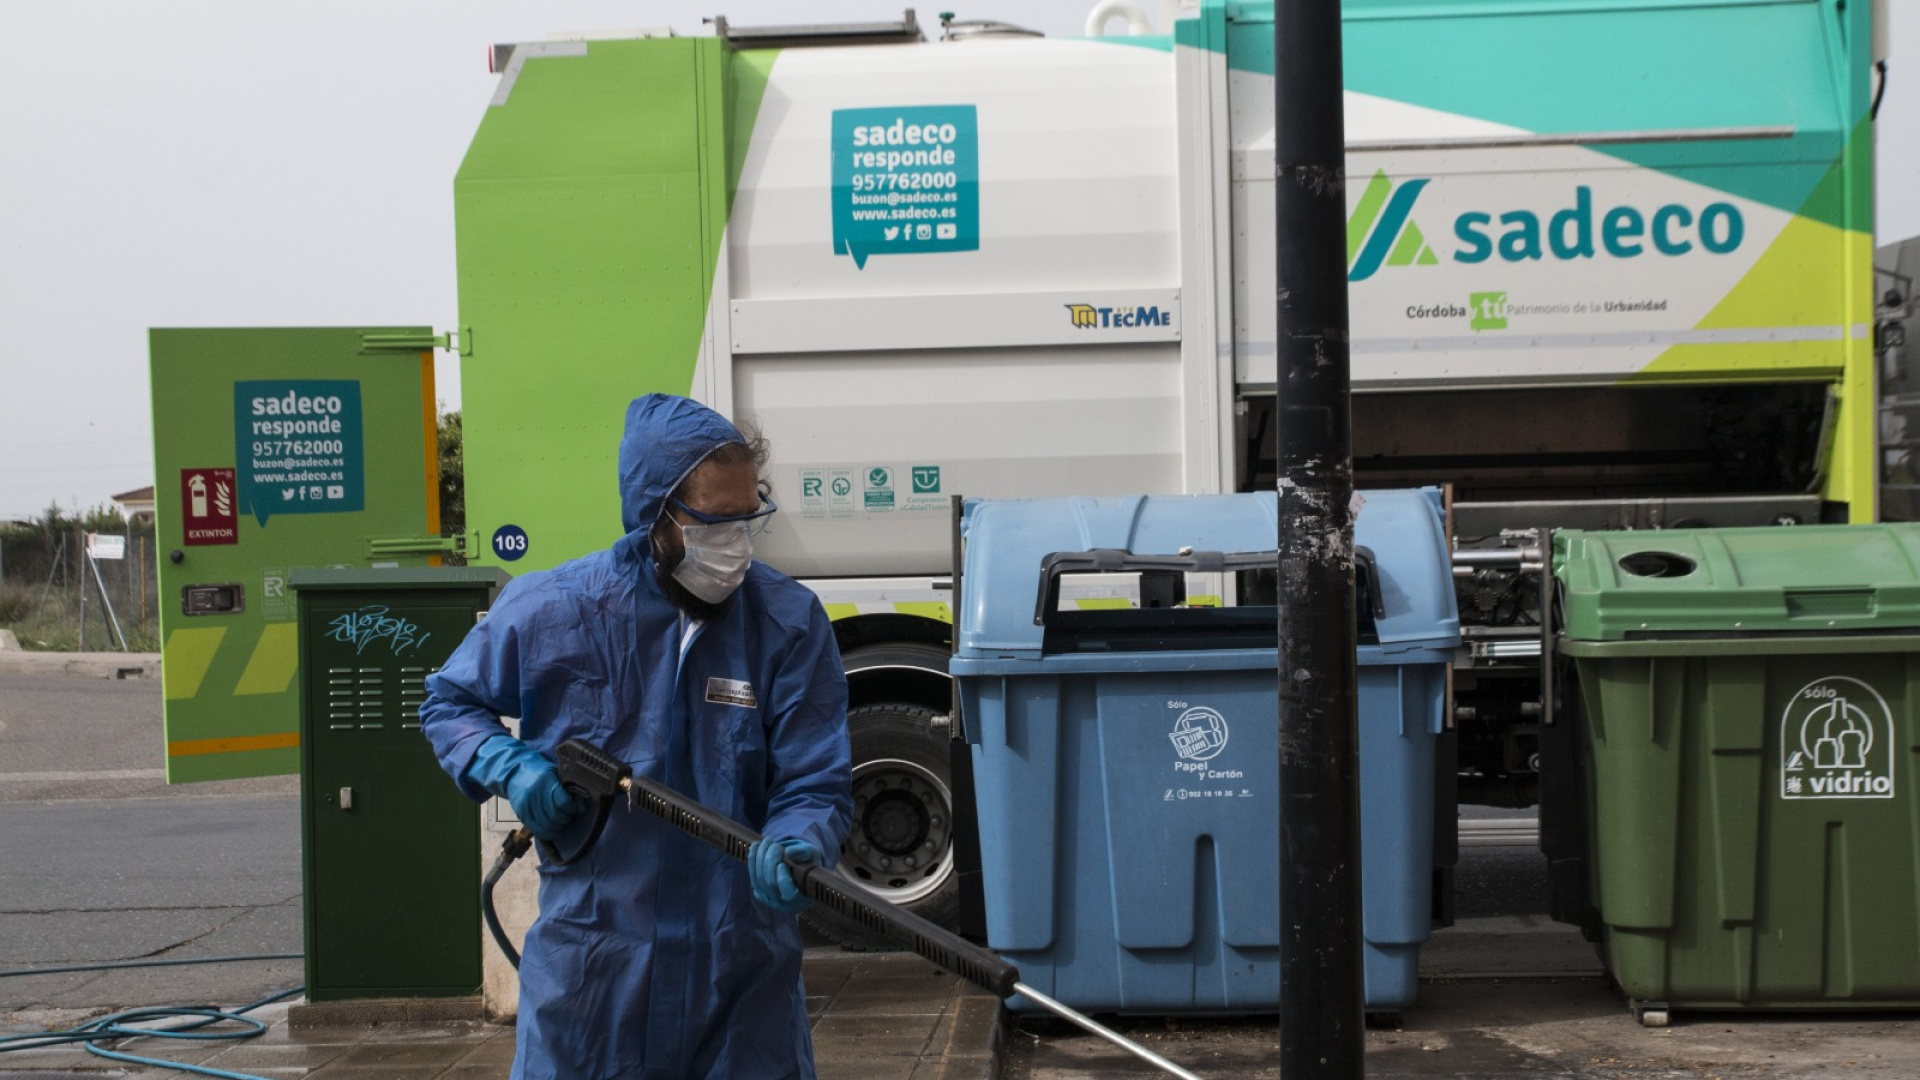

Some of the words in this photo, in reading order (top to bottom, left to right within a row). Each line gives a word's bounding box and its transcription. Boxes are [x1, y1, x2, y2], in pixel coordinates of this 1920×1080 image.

[853, 118, 957, 146] sadeco
[853, 145, 955, 172] responde
[852, 172, 957, 191] 957762000
[852, 191, 957, 206] buzon@sadeco.es
[852, 206, 956, 221] www.sadeco.es
[1453, 185, 1744, 264] sadeco
[1406, 304, 1466, 319] Córdoba
[1507, 303, 1570, 315] Patrimonio
[1573, 301, 1587, 313] de
[1590, 301, 1602, 313] la
[1603, 299, 1668, 313] Urbanidad
[252, 390, 342, 415] sadeco
[252, 415, 341, 439] responde
[252, 439, 343, 456] 957762000
[252, 457, 344, 469] buzon@sadeco.es
[253, 470, 343, 482] www.sadeco.es
[188, 529, 233, 539] EXTINTOR
[495, 535, 525, 550] 103
[1804, 686, 1837, 699] sólo
[1167, 700, 1188, 709] Sólo
[1174, 761, 1208, 773] Papel
[1199, 772, 1205, 780] y
[1208, 770, 1243, 779] Cartón
[1809, 770, 1890, 793] vidrio
